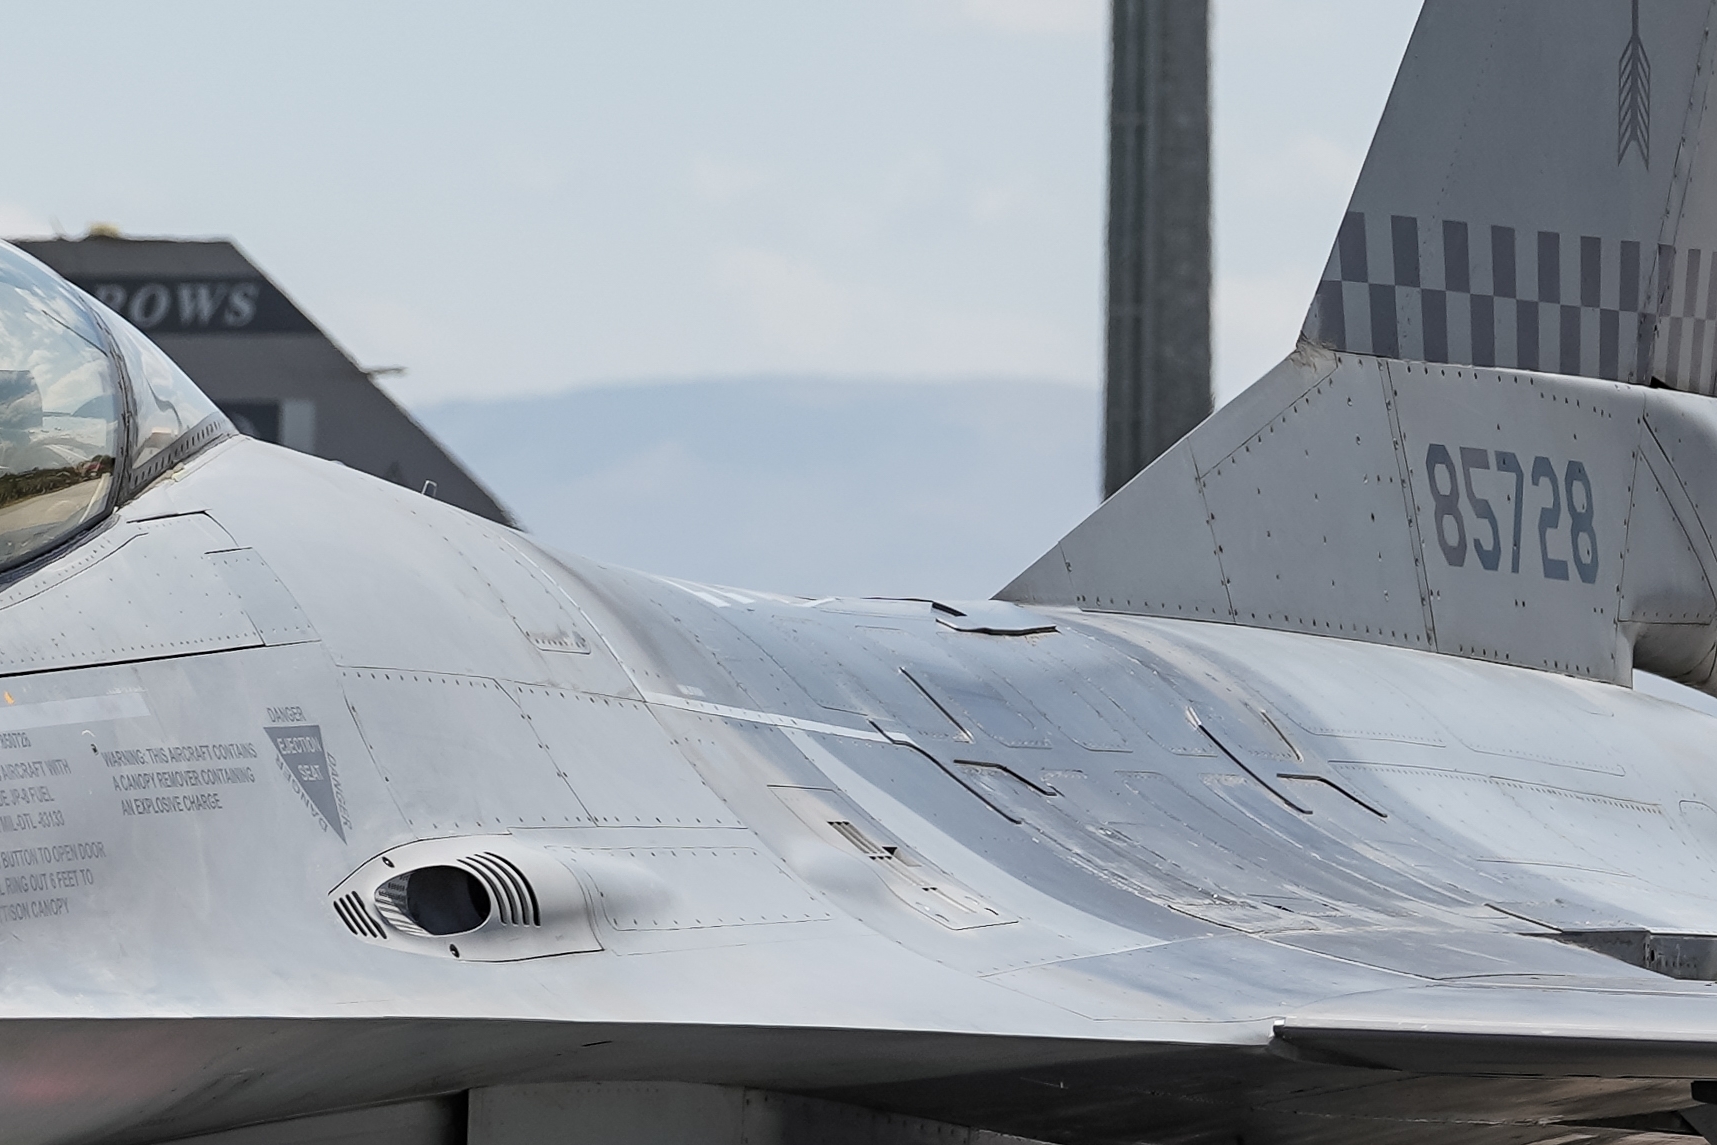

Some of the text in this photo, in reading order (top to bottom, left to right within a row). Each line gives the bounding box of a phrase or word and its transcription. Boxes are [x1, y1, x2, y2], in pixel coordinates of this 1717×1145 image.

[1426, 443, 1599, 584] 85728
[266, 706, 306, 722] DANGER
[146, 748, 169, 764] THIS
[169, 744, 213, 762] AIRCRAFT
[213, 743, 258, 760] CONTAINS
[277, 736, 323, 754] EJECTION
[1, 761, 46, 782] AIRCRAFT
[44, 759, 72, 777] WITH
[112, 767, 256, 791] A CANOPY REMOVER CONTAINING
[297, 764, 324, 781] SEAT
[28, 786, 55, 804] FUEL
[327, 751, 352, 830] DANGER
[121, 793, 223, 815] AN EXPLOSIVE CHARGE
[2, 849, 38, 869] BUTTON
[37, 847, 52, 864] TO
[52, 844, 79, 863] OPEN
[78, 841, 107, 860] DOOR
[6, 876, 29, 896] RING
[29, 873, 49, 892] OUT
[49, 873, 57, 889] 6
[56, 869, 80, 888] FEET
[79, 869, 94, 885] TO
[30, 898, 70, 918] CANOPY
